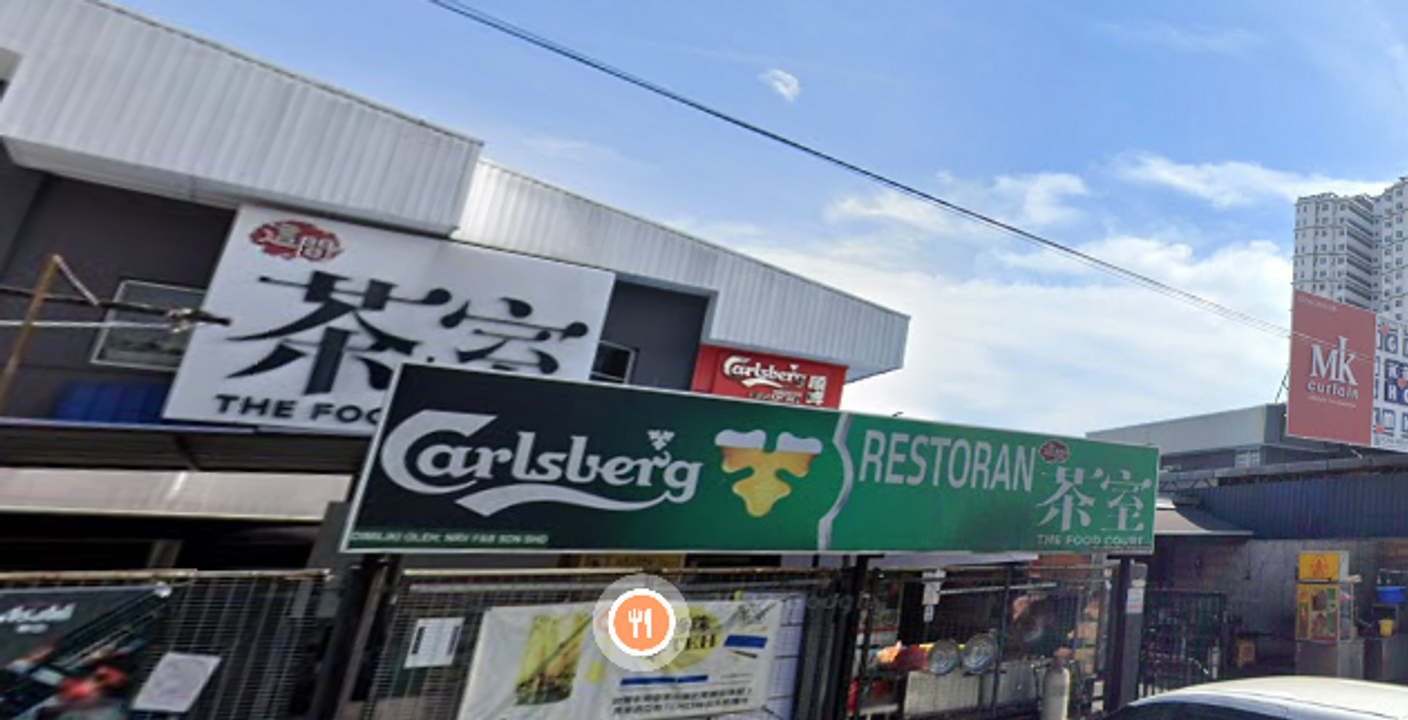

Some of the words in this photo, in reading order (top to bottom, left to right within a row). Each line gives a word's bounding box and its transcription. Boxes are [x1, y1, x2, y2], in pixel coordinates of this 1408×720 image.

[723, 355, 806, 388] Carlsberg
[216, 394, 297, 420] THE
[1307, 381, 1360, 400] curtain
[380, 409, 704, 505] Carlsberg
[858, 429, 1036, 492] RESTORAN
[1036, 466, 1153, 531] 茶室
[1036, 534, 1062, 545] THE
[1065, 534, 1101, 546] FOOD
[1104, 534, 1145, 546] COURT
